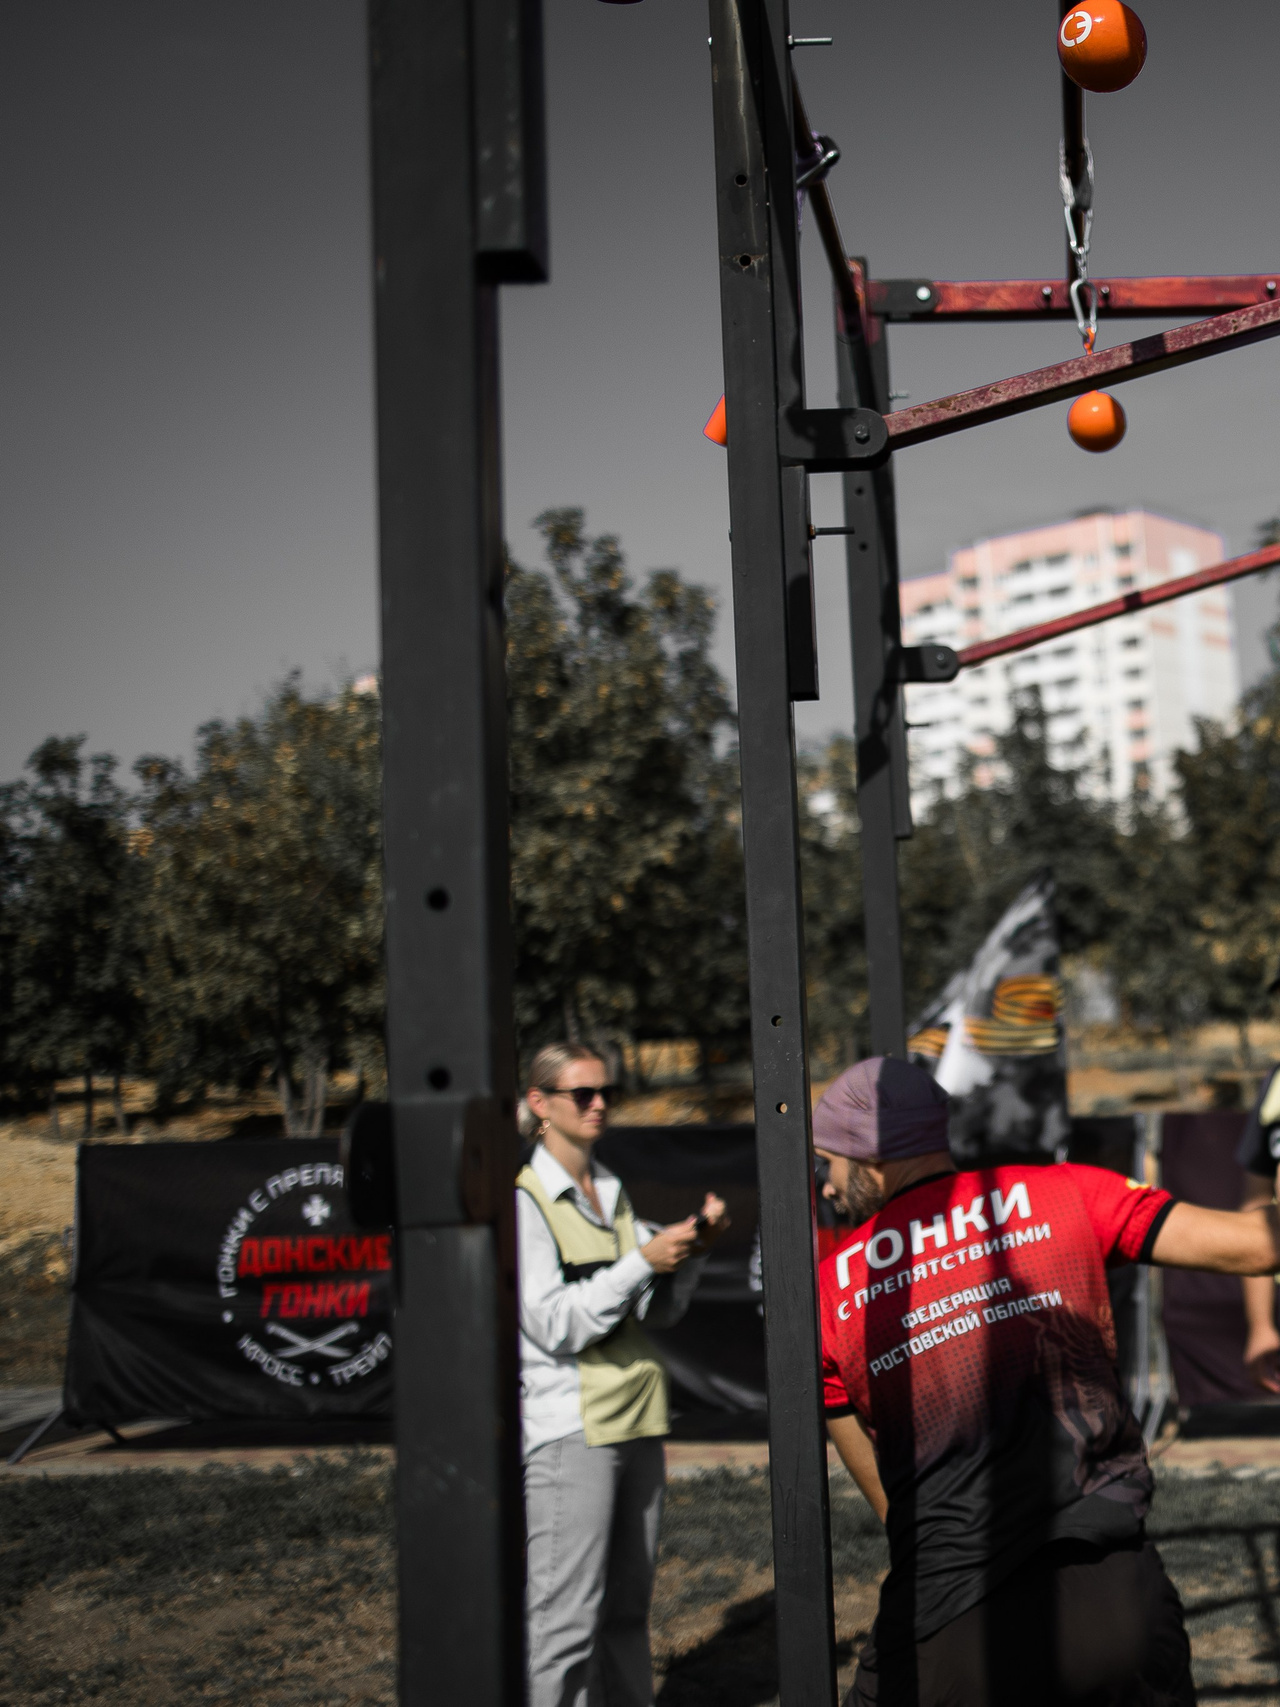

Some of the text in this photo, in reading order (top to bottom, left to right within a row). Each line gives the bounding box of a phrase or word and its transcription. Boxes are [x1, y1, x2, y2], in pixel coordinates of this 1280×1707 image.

[237, 1234, 393, 1278] ДОНСКИЕ
[834, 1181, 1033, 1291] ГОНКИ
[836, 1221, 1052, 1322] С ПРЕПЯТСТВИЯМИ
[259, 1281, 372, 1319] ГОНКИ
[869, 1288, 1063, 1377] РОСТОВСКОЙ ОБЛАСТИ
[901, 1276, 1012, 1329] ФЕДЕРАЦИЯ
